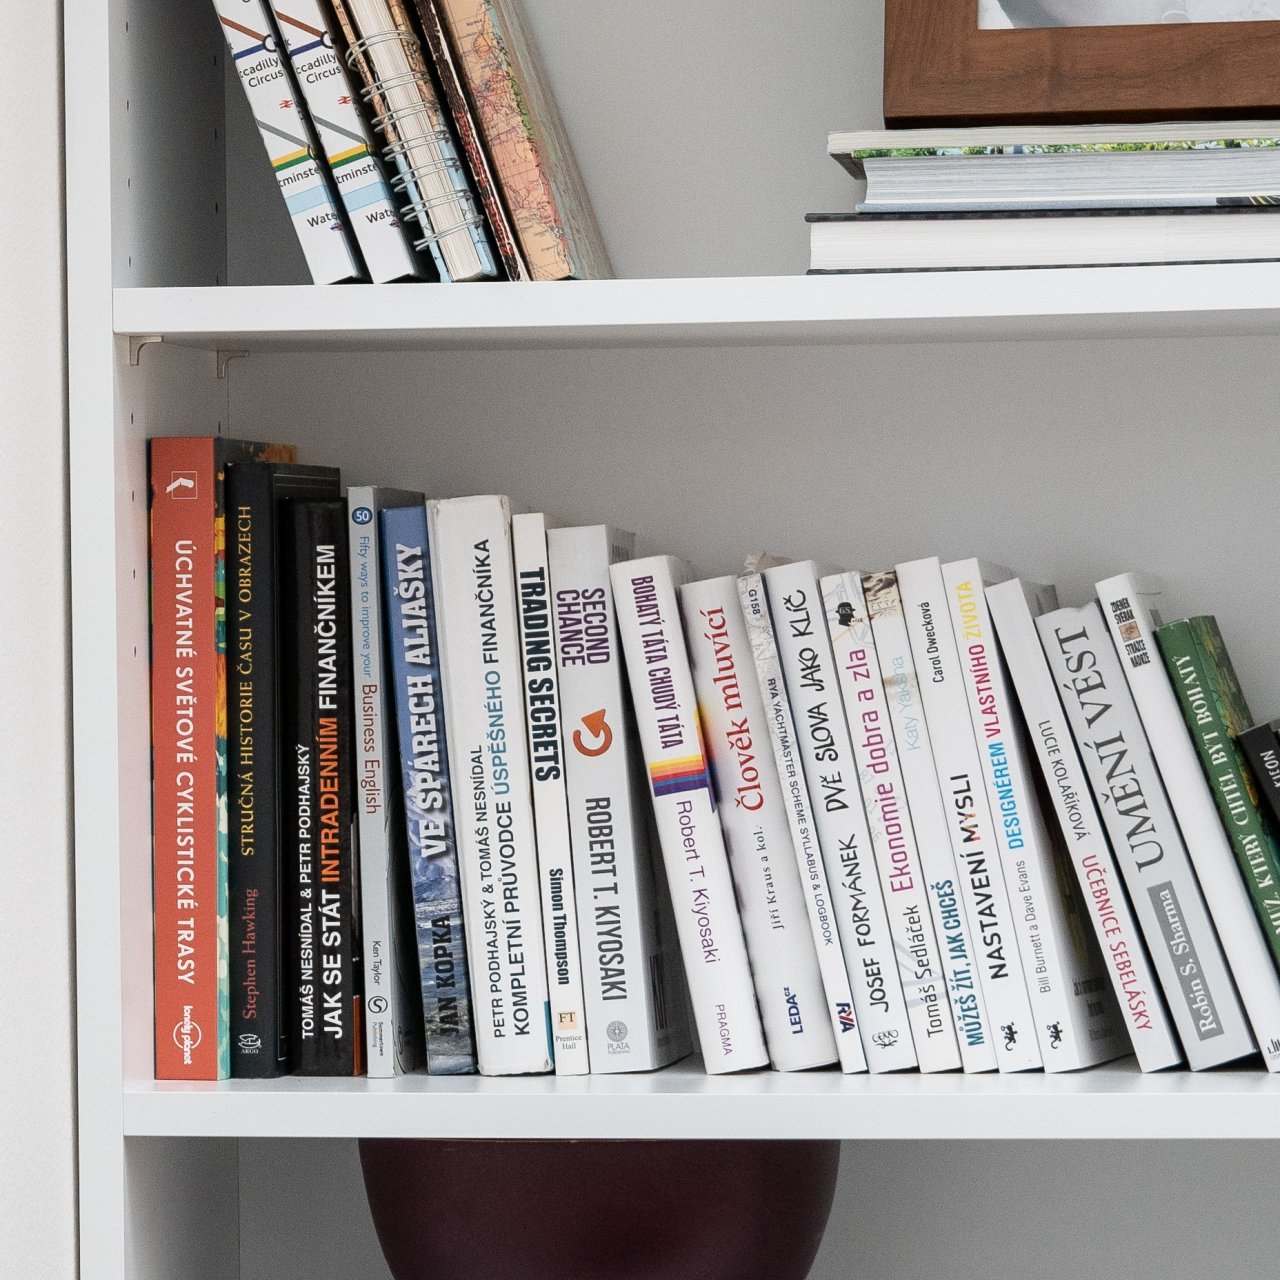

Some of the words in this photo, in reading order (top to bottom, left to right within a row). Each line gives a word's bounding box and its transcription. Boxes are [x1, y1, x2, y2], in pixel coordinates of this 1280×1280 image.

[306, 66, 342, 84] Circus
[355, 510, 369, 521] 50
[237, 506, 251, 603] OBRAZECH
[356, 535, 370, 558] Fifty
[357, 561, 368, 588] ways
[174, 539, 196, 657] ÚCHVATNÉ
[238, 609, 252, 621] V
[313, 544, 337, 709] FINANČNÍKEM
[358, 605, 371, 649] improve
[360, 590, 369, 603] to
[394, 544, 431, 666] ALJAŠKY
[472, 539, 498, 663] FINANČNÍKA
[520, 567, 551, 672] TRADING
[581, 587, 610, 664] SECOND
[747, 588, 761, 615] G158
[955, 580, 982, 638] ŽIVOTA
[236, 627, 252, 675] ČASU
[556, 589, 588, 666] CHANCE
[918, 601, 938, 654] Dwecková
[359, 652, 371, 678] your
[699, 607, 742, 710] mluvící
[767, 677, 779, 699] RYA
[845, 648, 870, 681] zla
[928, 654, 944, 683] Carol
[1054, 627, 1111, 727] VÉST
[175, 666, 197, 762] SVĚTOVÉ
[361, 683, 378, 752] Business
[857, 687, 874, 702] a
[968, 643, 1000, 737] VLASTNÍHO
[239, 681, 253, 764] HISTORIE
[407, 675, 443, 810] SPÁRECH
[483, 670, 509, 795] ÚSPĚŠNÉHO
[528, 677, 560, 781] SECRETS
[772, 700, 796, 777] YACHTMASTER
[861, 709, 889, 774] dobra
[359, 758, 381, 814] English
[469, 744, 487, 822] NESNÍDAL
[725, 717, 763, 810] Člověk
[1037, 719, 1060, 756] LUCIE
[1051, 758, 1090, 840] KOLAŘÍKOVÁ
[237, 771, 254, 855] STRUČNÁ
[316, 717, 339, 882] INTRADENNÍM
[788, 780, 806, 824] SCHEME
[949, 773, 980, 843] MYSLI
[988, 742, 1024, 849] DESIGNÉREM
[1084, 732, 1163, 870] UMĚNÍ
[175, 771, 197, 908] CYKLISTICKÉ
[418, 817, 447, 857] VE
[474, 826, 492, 881] TOMÁŠ
[495, 801, 519, 913] PRŮVODCE
[585, 796, 616, 876] ROBERT
[676, 799, 700, 860] Robert
[799, 826, 819, 880] SYLLABUS
[882, 783, 913, 891] Ekonomie
[481, 883, 494, 894] &
[548, 867, 564, 911] Simon
[592, 881, 618, 899] T.
[688, 864, 705, 882] T.
[811, 883, 821, 891] &
[241, 888, 258, 953] Hawking
[317, 888, 341, 946] STÁT
[691, 887, 720, 963] Kiyosaki
[813, 892, 833, 945] LOGBOOK
[902, 904, 932, 979] Sedláček
[970, 850, 1008, 979] NASTAVENÍ
[1081, 854, 1121, 937] UČEBNICE
[1109, 940, 1152, 1029] SEBELÁSKY
[1159, 889, 1189, 955] Sharma
[176, 917, 195, 983] TRASY
[322, 953, 342, 985] SE
[370, 959, 382, 985] Taylor
[371, 939, 381, 958] Ken
[480, 899, 501, 993] PODHAJSKÝ
[552, 913, 569, 985] Thompson
[595, 905, 626, 1000] KIYOSAKI
[1179, 957, 1197, 976] S.
[242, 958, 259, 1019] Stephen
[502, 919, 529, 1035] KOMPLETNÍ
[1189, 978, 1216, 1032] Robin
[179, 1004, 194, 1034] lonely
[322, 991, 343, 1039] JAK
[490, 997, 505, 1038] PETR
[559, 1012, 576, 1023] FT
[715, 1003, 733, 1055] PRAGMA
[835, 999, 855, 1033] RYA
[918, 984, 943, 1038] Tomáš
[179, 1033, 194, 1064] planet
[562, 1042, 577, 1050] Hall
